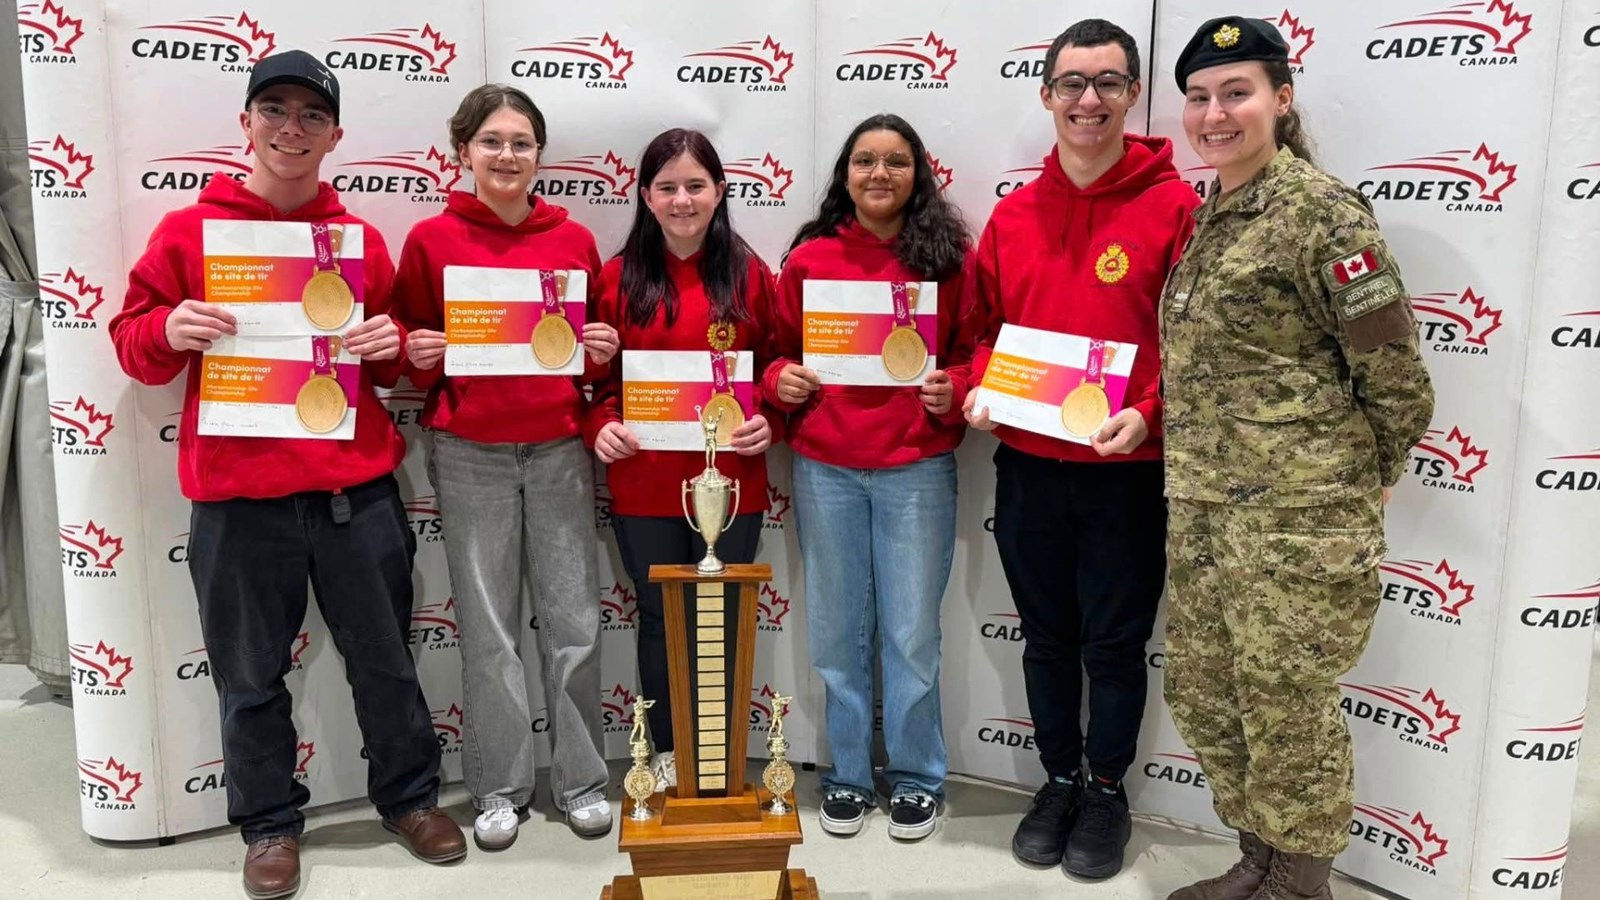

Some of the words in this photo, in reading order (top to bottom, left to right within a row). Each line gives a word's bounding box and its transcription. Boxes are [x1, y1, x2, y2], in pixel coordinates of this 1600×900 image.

[132, 38, 240, 63] CADETS
[1366, 34, 1486, 60] CADETS
[30, 55, 76, 64] CANADA
[325, 51, 423, 72] CADETS
[1459, 56, 1518, 66] CANADA
[220, 64, 253, 73] CANA
[511, 60, 602, 80] CADETS
[677, 66, 763, 83] CADETS
[836, 63, 925, 81] CADETS
[1000, 60, 1046, 78] CAD
[405, 74, 450, 83] CANADA
[906, 82, 949, 90] CANADA
[332, 175, 428, 194] CADETS
[528, 179, 606, 196] ADETS
[726, 182, 763, 198] ETS
[40, 190, 87, 198] CANADA
[410, 195, 448, 203] CANAD
[1446, 203, 1503, 212] CANADA
[210, 262, 274, 272] Championnat
[225, 272, 241, 280] site
[257, 272, 268, 280] tir
[1346, 280, 1388, 304] SENTINEL
[1344, 288, 1398, 316] SENTINELLE
[450, 308, 507, 316] Championnat
[450, 316, 460, 324] de
[463, 316, 478, 324] site
[480, 316, 490, 324] de
[492, 316, 502, 324] tir
[52, 320, 97, 328] CANADA
[808, 318, 859, 327] Championnat
[1433, 344, 1488, 355] CANADA
[208, 362, 272, 373] Championnat
[208, 371, 220, 380] de
[222, 372, 238, 380] site
[240, 373, 252, 381] de
[254, 374, 264, 382] tir
[628, 386, 680, 395] Championnat
[63, 448, 107, 456] CANADA
[1422, 478, 1475, 493] CANADA
[1536, 470, 1600, 490] CAD
[62, 548, 88, 568] ETS
[74, 570, 117, 578] CANADA
[1380, 582, 1434, 608] ETS
[1410, 608, 1462, 626] CANADA
[1520, 606, 1598, 628] CADE
[408, 626, 446, 644] ETS
[601, 624, 636, 632] ANADA
[981, 623, 1025, 642] CAD
[428, 642, 460, 650] CANA
[72, 665, 98, 687] ETS
[84, 688, 126, 696] CANADA
[1340, 697, 1421, 734] ADETS
[603, 726, 634, 734] ANAD
[978, 727, 1036, 750] CADE
[1400, 733, 1448, 754] CANADA
[1506, 737, 1582, 762] CADE
[1144, 762, 1206, 788] CADE
[80, 779, 108, 801] ETS
[94, 802, 136, 810] CANADA
[1349, 819, 1411, 855] DETS
[1389, 852, 1436, 876] CANADA
[1492, 862, 1566, 890] CADE
